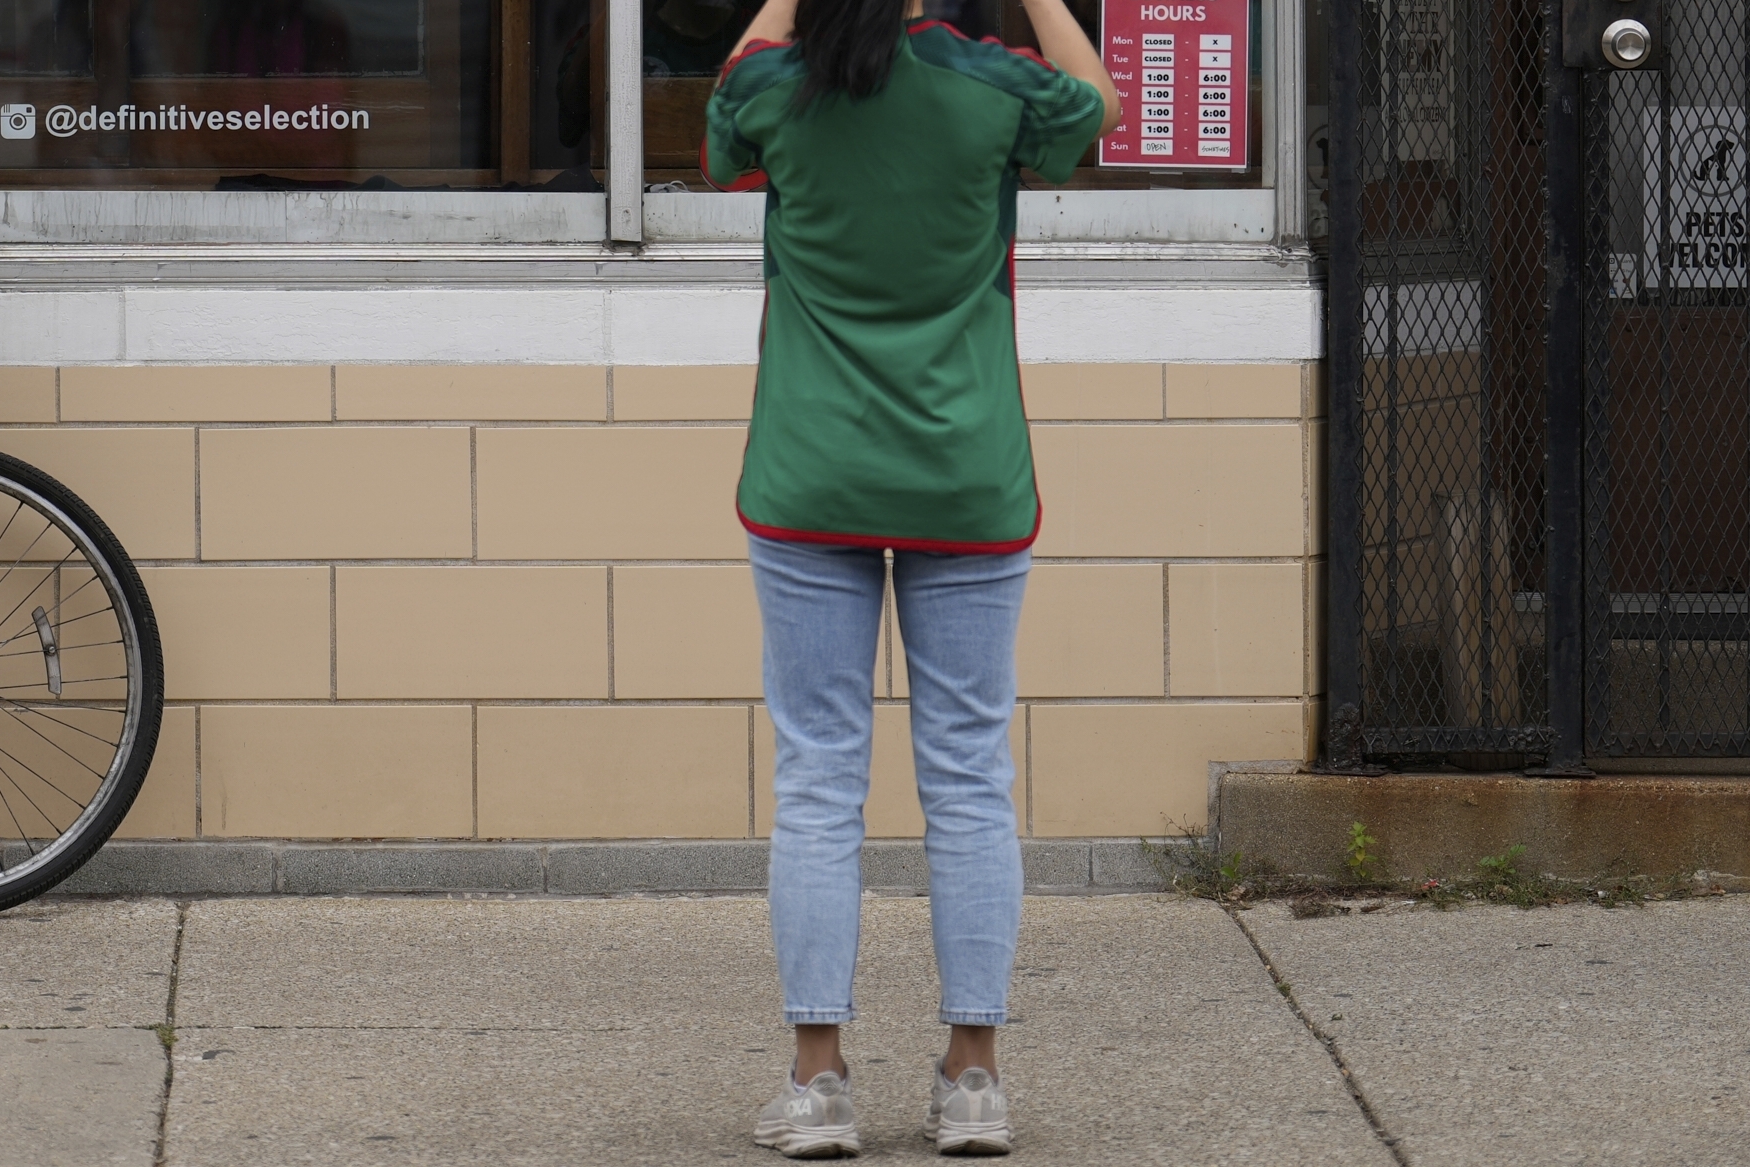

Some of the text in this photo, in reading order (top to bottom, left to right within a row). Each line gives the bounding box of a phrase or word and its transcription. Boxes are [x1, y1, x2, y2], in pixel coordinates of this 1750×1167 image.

[1140, 5, 1206, 22] HOURS
[1112, 36, 1133, 45] Mon
[1112, 54, 1129, 63] Tue
[1111, 71, 1133, 80] Wed
[1147, 74, 1169, 82] 1:00
[1203, 75, 1227, 83] 6:00
[1116, 89, 1129, 98] hu
[1147, 90, 1169, 98] 1:00
[1202, 92, 1226, 100] 6:00
[1147, 108, 1169, 116] 1:00
[1202, 109, 1226, 118] 6:00
[45, 104, 370, 138] @definitiveselection
[1114, 124, 1127, 132] at
[1147, 126, 1169, 134] 1:00
[1202, 126, 1226, 135] 6:00
[1110, 142, 1129, 151] Sun
[1146, 143, 1167, 152] OPEN
[1685, 211, 1745, 237] PETS
